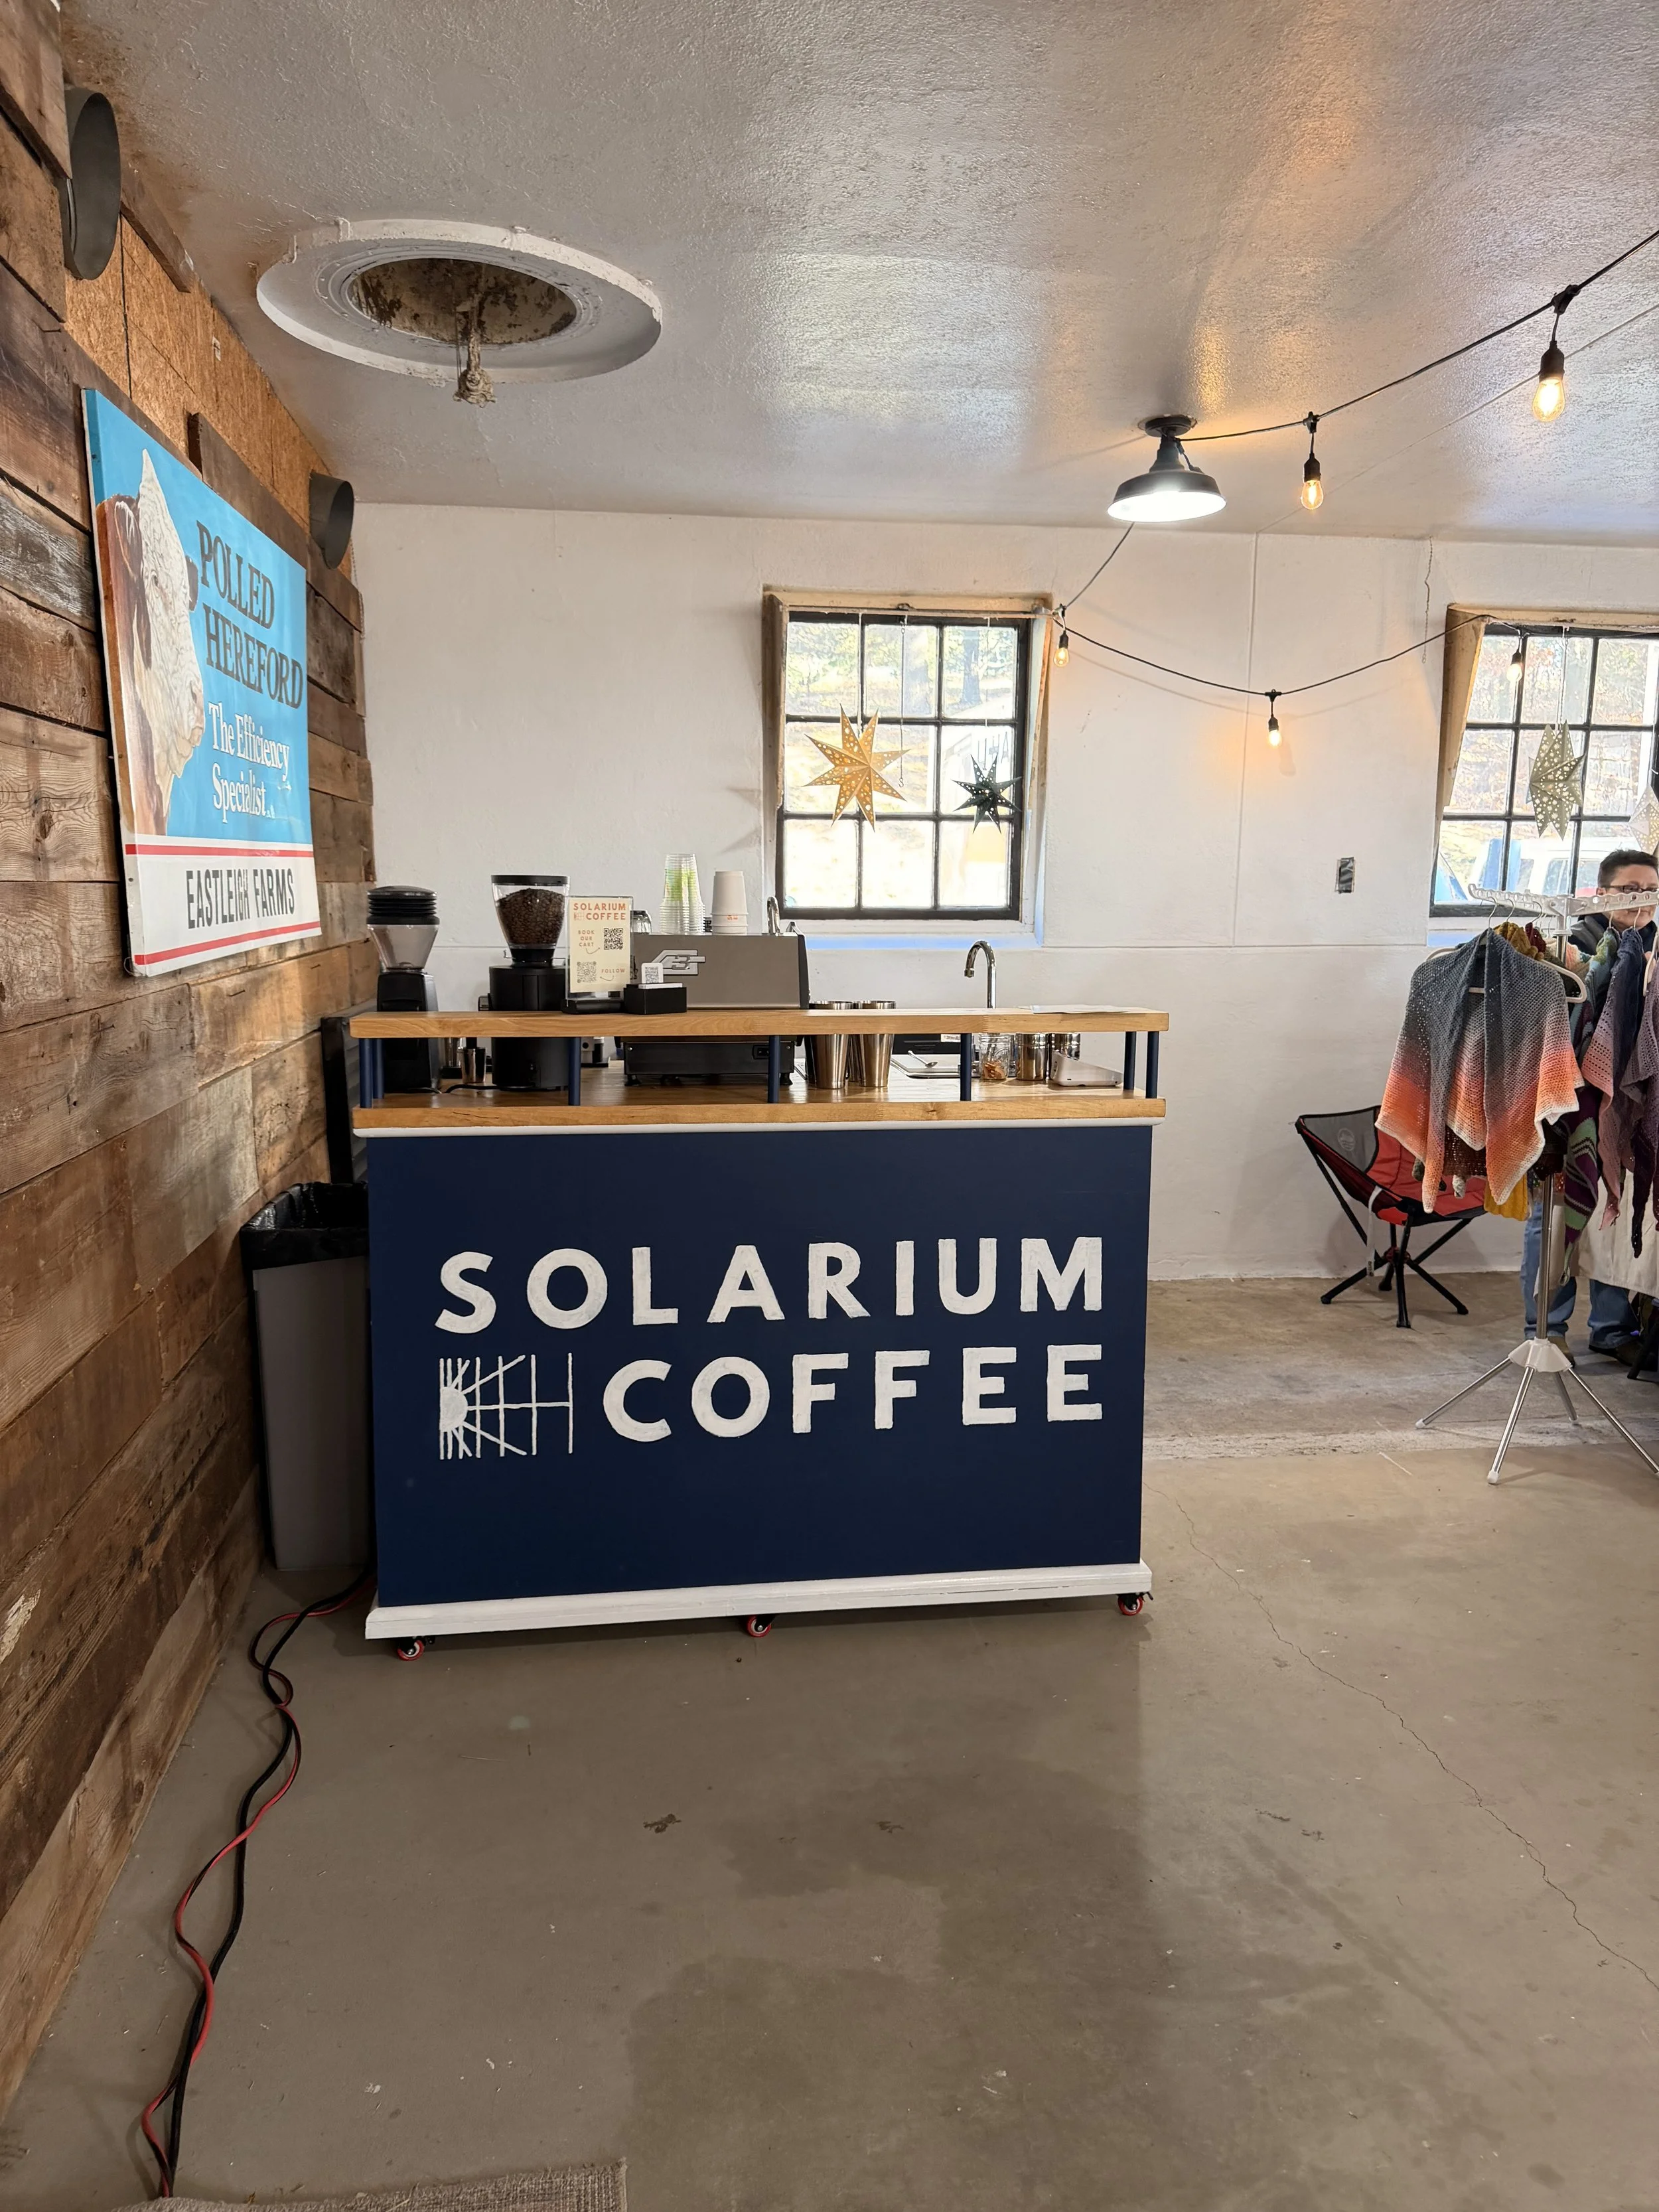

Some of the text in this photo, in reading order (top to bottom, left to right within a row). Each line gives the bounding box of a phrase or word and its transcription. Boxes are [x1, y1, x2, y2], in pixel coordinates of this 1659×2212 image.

[196, 520, 274, 629] POLLED
[202, 603, 303, 709] HEREFORD
[208, 701, 290, 782] The Efficiency
[186, 868, 295, 929] EASTLEIGH FARMS
[435, 1236, 1102, 1334] SOLARIUM
[603, 1344, 1102, 1442] COFFEE
